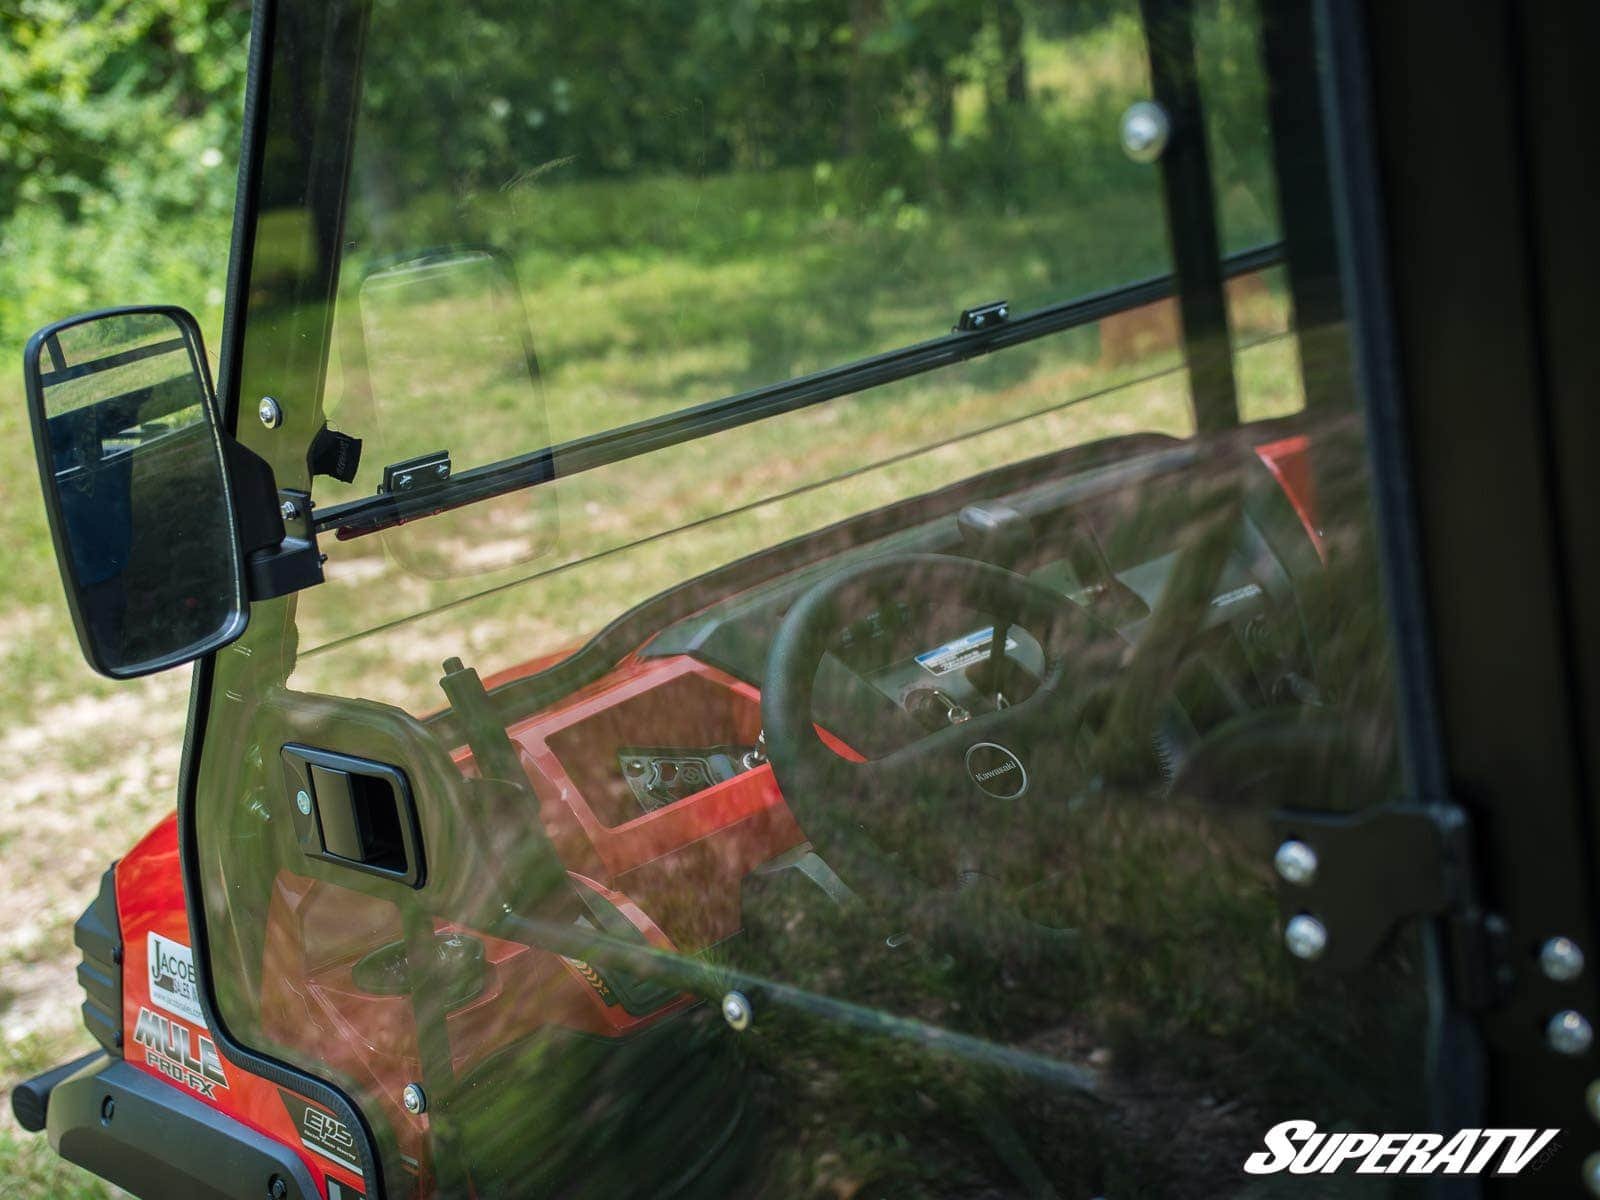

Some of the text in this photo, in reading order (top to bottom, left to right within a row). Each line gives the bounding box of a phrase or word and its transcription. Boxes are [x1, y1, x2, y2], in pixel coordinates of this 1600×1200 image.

[975, 760, 1017, 782] Kawasaki
[133, 1007, 229, 1089] MULE
[146, 1050, 217, 1101] PRO-FX
[304, 1107, 354, 1147] EPS
